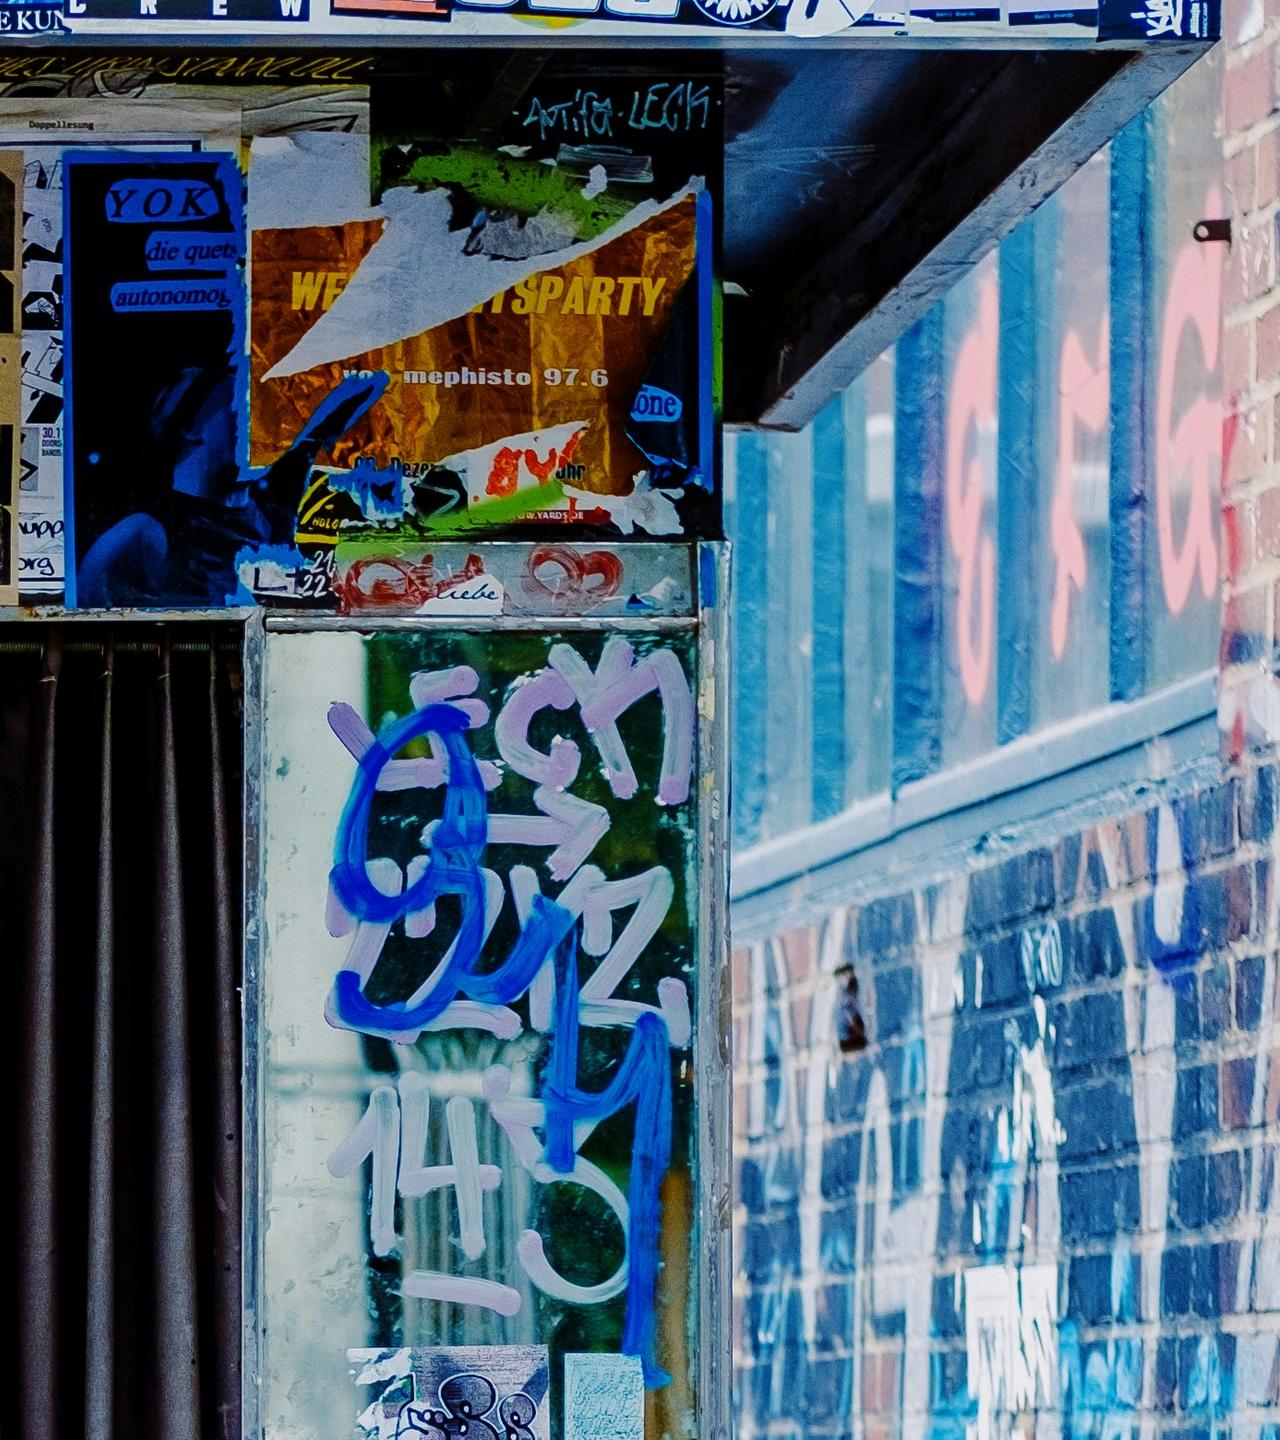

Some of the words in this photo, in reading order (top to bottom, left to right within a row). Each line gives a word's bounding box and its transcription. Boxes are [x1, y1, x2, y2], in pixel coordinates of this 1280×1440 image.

[29, 120, 94, 131] Doppellesung
[147, 241, 179, 262] die
[404, 368, 531, 386] mephisto
[544, 368, 609, 386] 97.6
